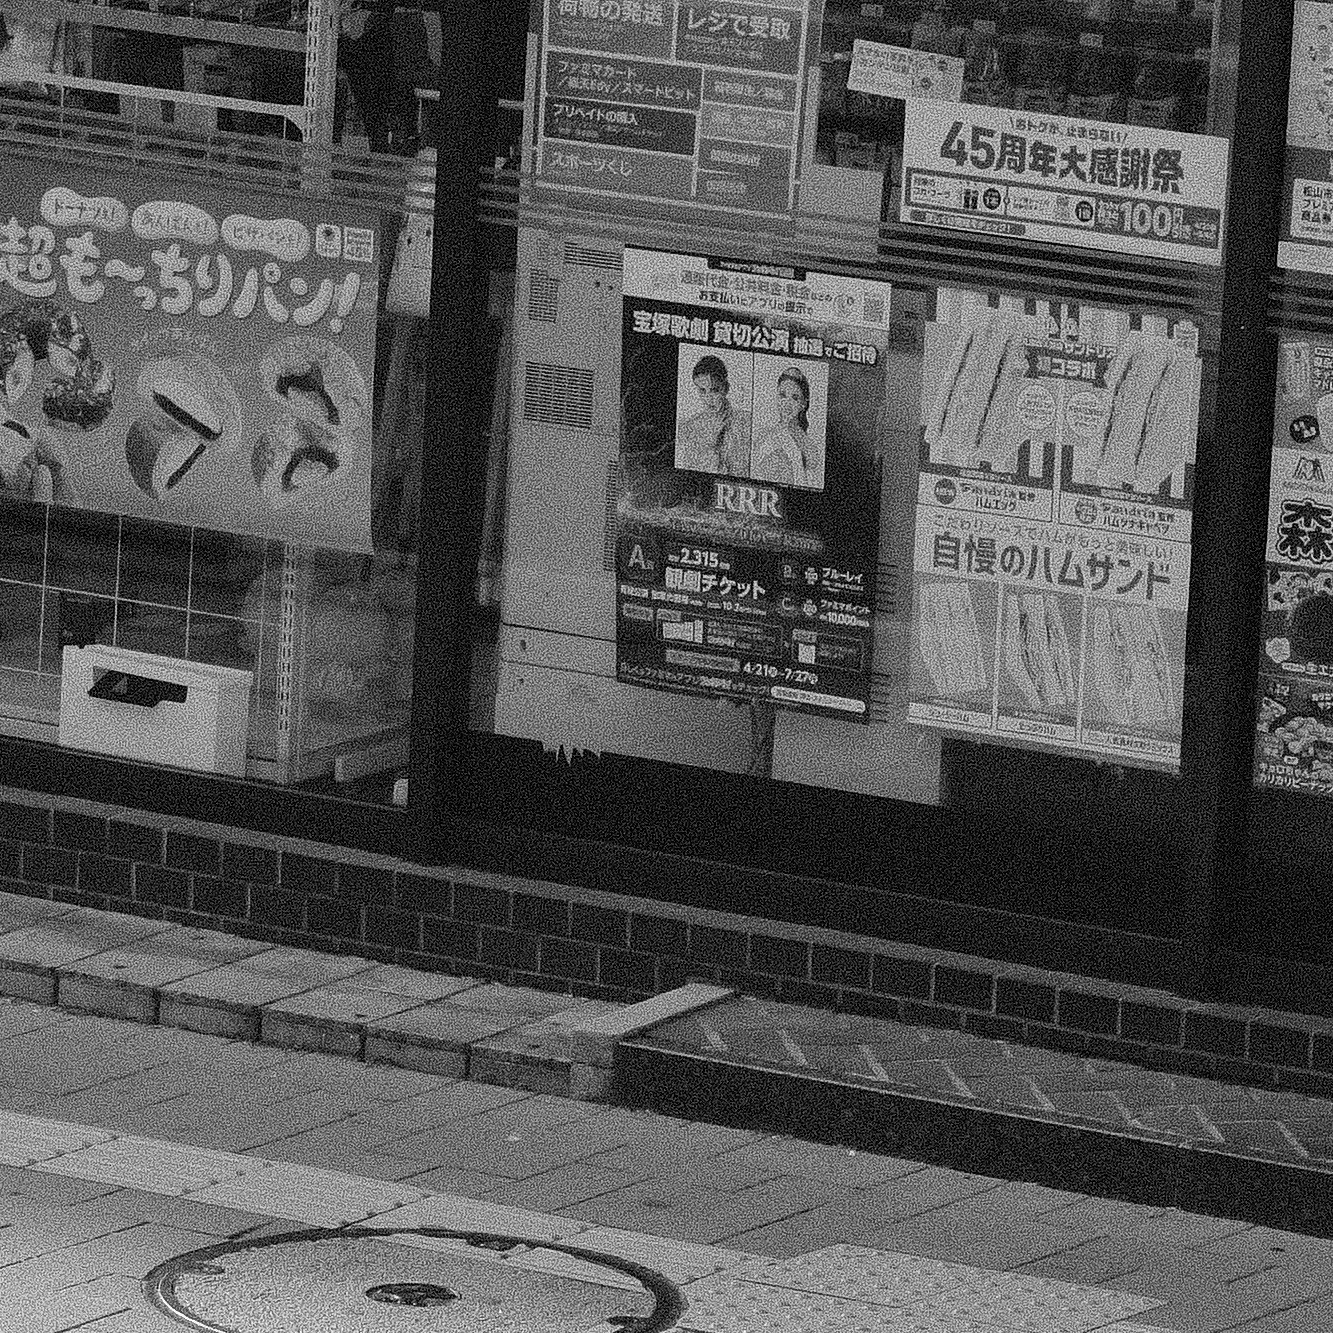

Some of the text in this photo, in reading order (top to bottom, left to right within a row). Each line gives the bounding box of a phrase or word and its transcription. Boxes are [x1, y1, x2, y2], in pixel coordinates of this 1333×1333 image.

[687, 8, 791, 41] レジで受取
[550, 152, 632, 177] スポーツくじ
[939, 121, 1184, 194] 45周年大感謝祭
[633, 310, 709, 341] 宝塚歌劇
[714, 482, 782, 518] RRR
[932, 531, 1171, 600] 自慢のハムサンド
[665, 567, 766, 599] 観劇チケット
